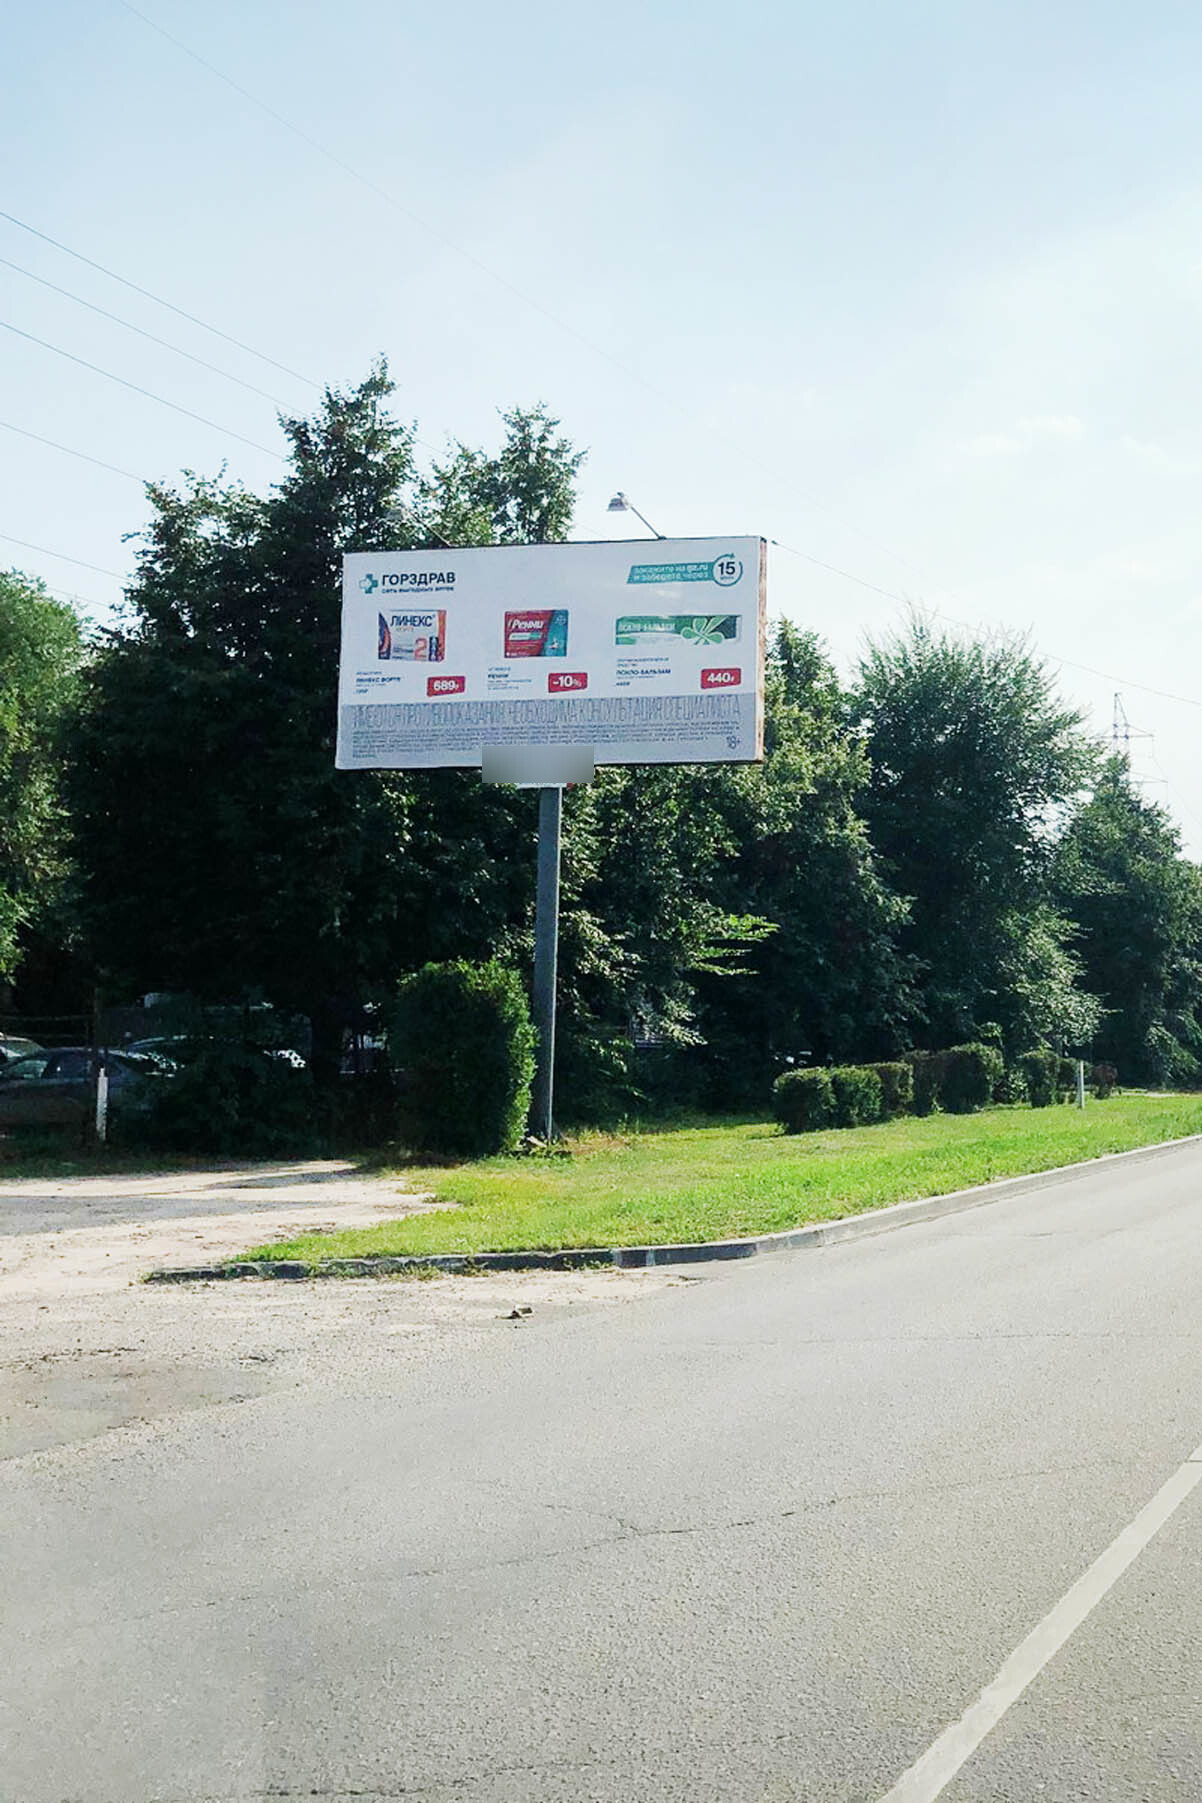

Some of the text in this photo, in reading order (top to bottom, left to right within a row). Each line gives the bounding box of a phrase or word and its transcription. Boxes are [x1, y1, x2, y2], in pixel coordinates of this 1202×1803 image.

[718, 561, 735, 575] 15
[382, 572, 456, 586] ГОРЗДРАВ
[390, 615, 433, 627] ЛИНЕКС
